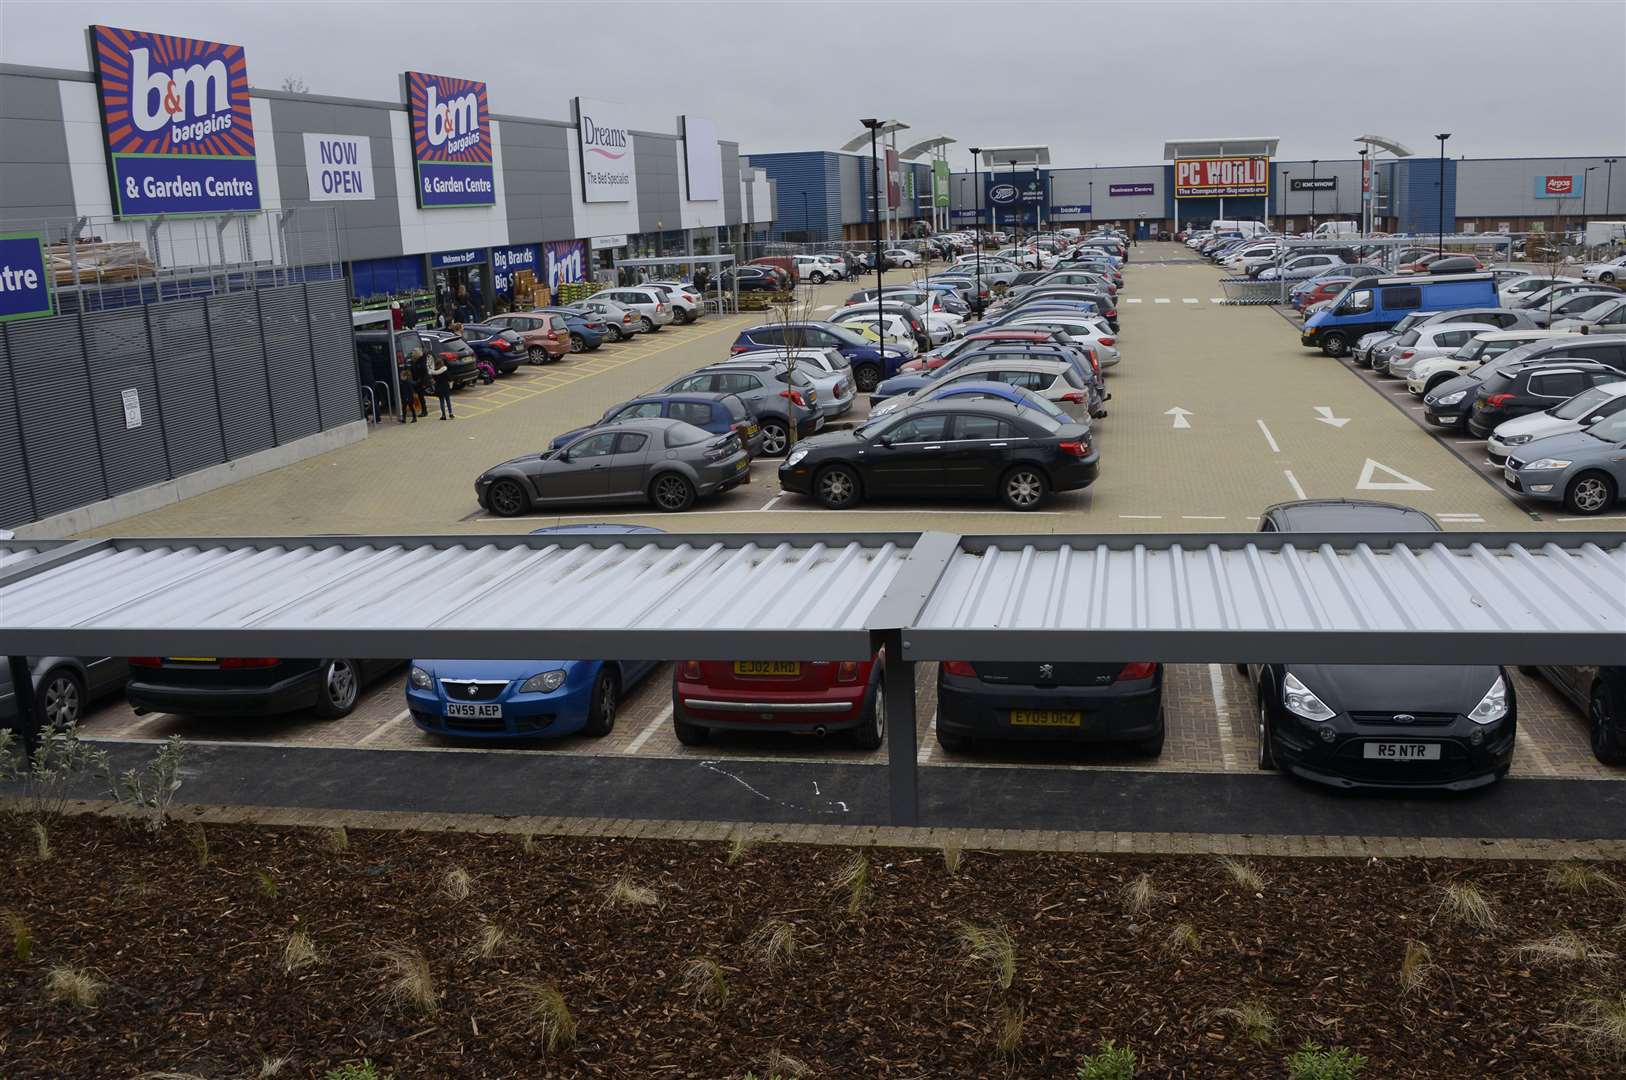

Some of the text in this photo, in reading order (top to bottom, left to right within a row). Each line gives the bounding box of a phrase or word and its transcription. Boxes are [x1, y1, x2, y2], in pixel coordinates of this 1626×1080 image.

[128, 48, 232, 131] b&m
[426, 86, 480, 146] b&m
[172, 114, 232, 143] bargains
[583, 117, 626, 148] Dreams
[320, 141, 357, 165] NOW
[448, 132, 480, 154] bargains
[321, 170, 363, 194] OPEN
[587, 172, 597, 184] The
[598, 172, 608, 184] Bed
[1178, 160, 1266, 186] PC WORLD
[1548, 178, 1571, 188] Argos
[126, 175, 253, 199] & Garden Centre
[424, 176, 492, 193] & Garden Centre
[1191, 187, 1225, 195] Computer
[1226, 187, 1265, 195] Superstore
[494, 248, 533, 269] Big Brands
[495, 272, 508, 292] Big
[448, 704, 499, 717] GV59 AEP
[1015, 711, 1047, 724] EY09
[1378, 744, 1426, 757] R5 NTR
